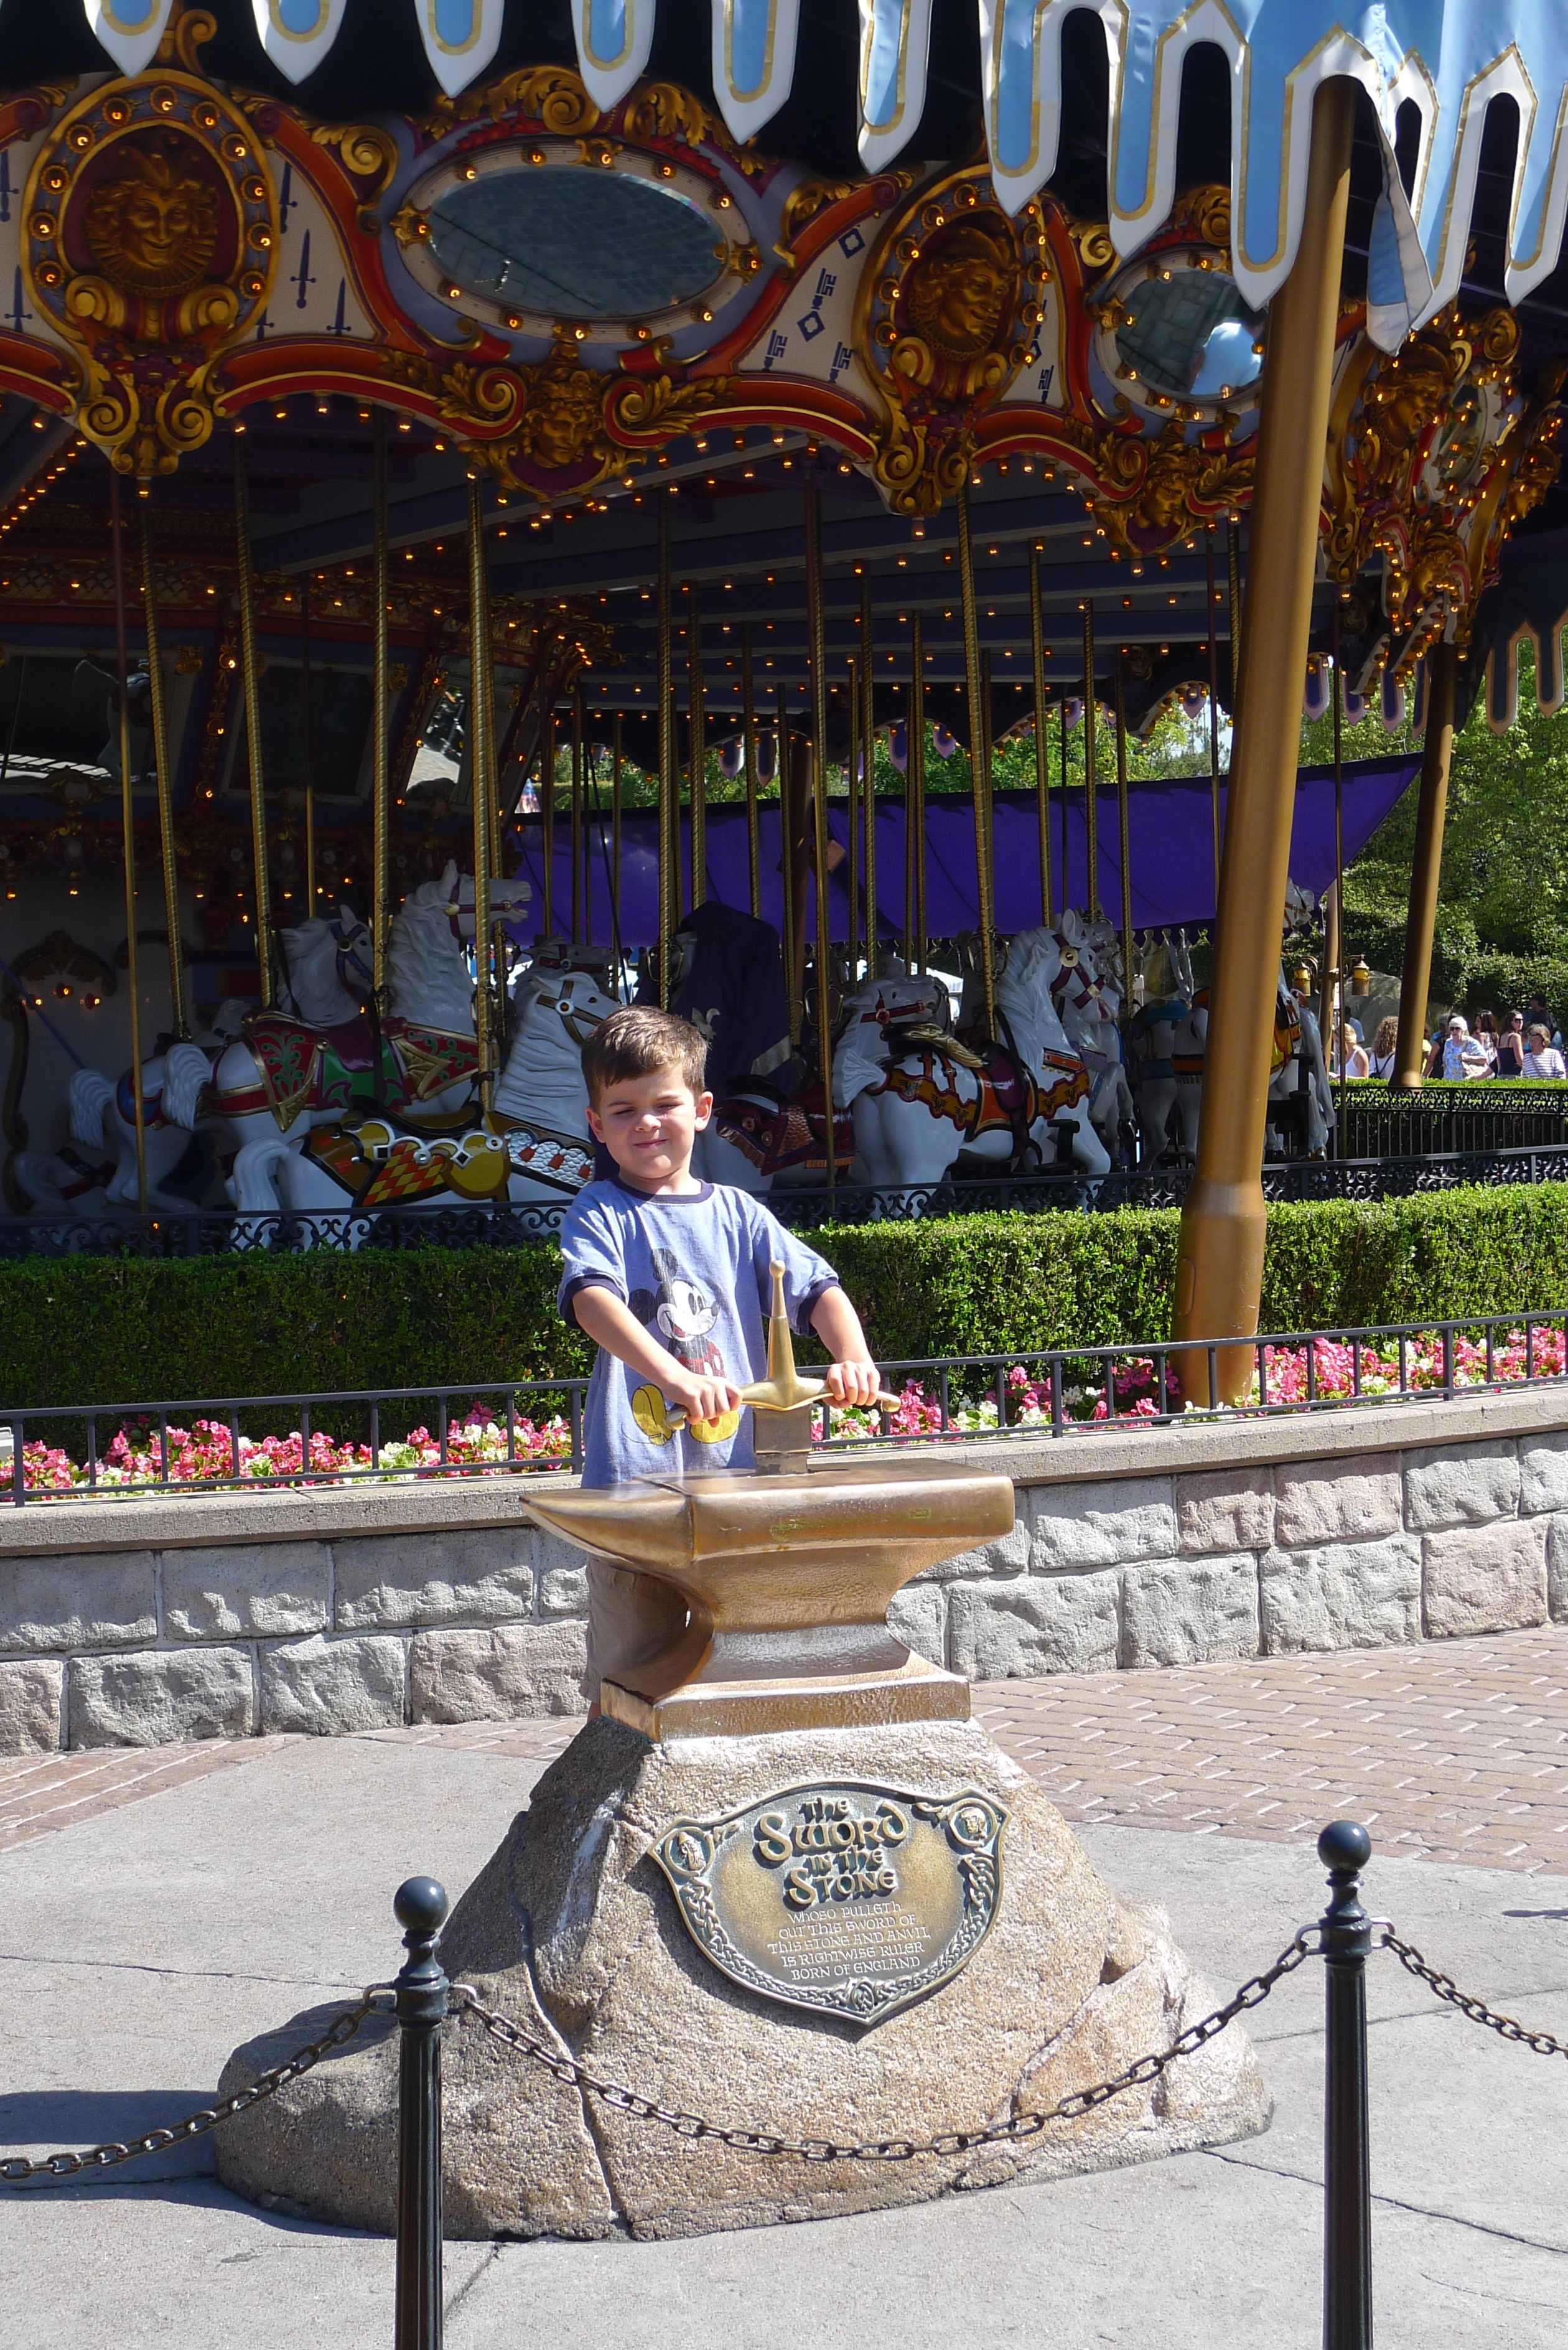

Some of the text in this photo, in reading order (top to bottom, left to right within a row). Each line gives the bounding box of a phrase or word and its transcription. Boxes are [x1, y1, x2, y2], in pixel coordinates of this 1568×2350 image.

[759, 1801, 908, 1861] SWORD
[810, 1854, 833, 1871] IN
[790, 1867, 896, 1904] STONE
[779, 1925, 806, 1939] OUT
[846, 1916, 895, 1931] SWORD
[900, 1913, 915, 1926] OF
[805, 1935, 849, 1950] STONE
[853, 1931, 884, 1945] AND
[887, 1927, 931, 1942] ANVIL
[782, 1955, 796, 1968] IS
[880, 1941, 925, 1956] RULER
[791, 1956, 920, 1980] BORN OF ENGLAND
